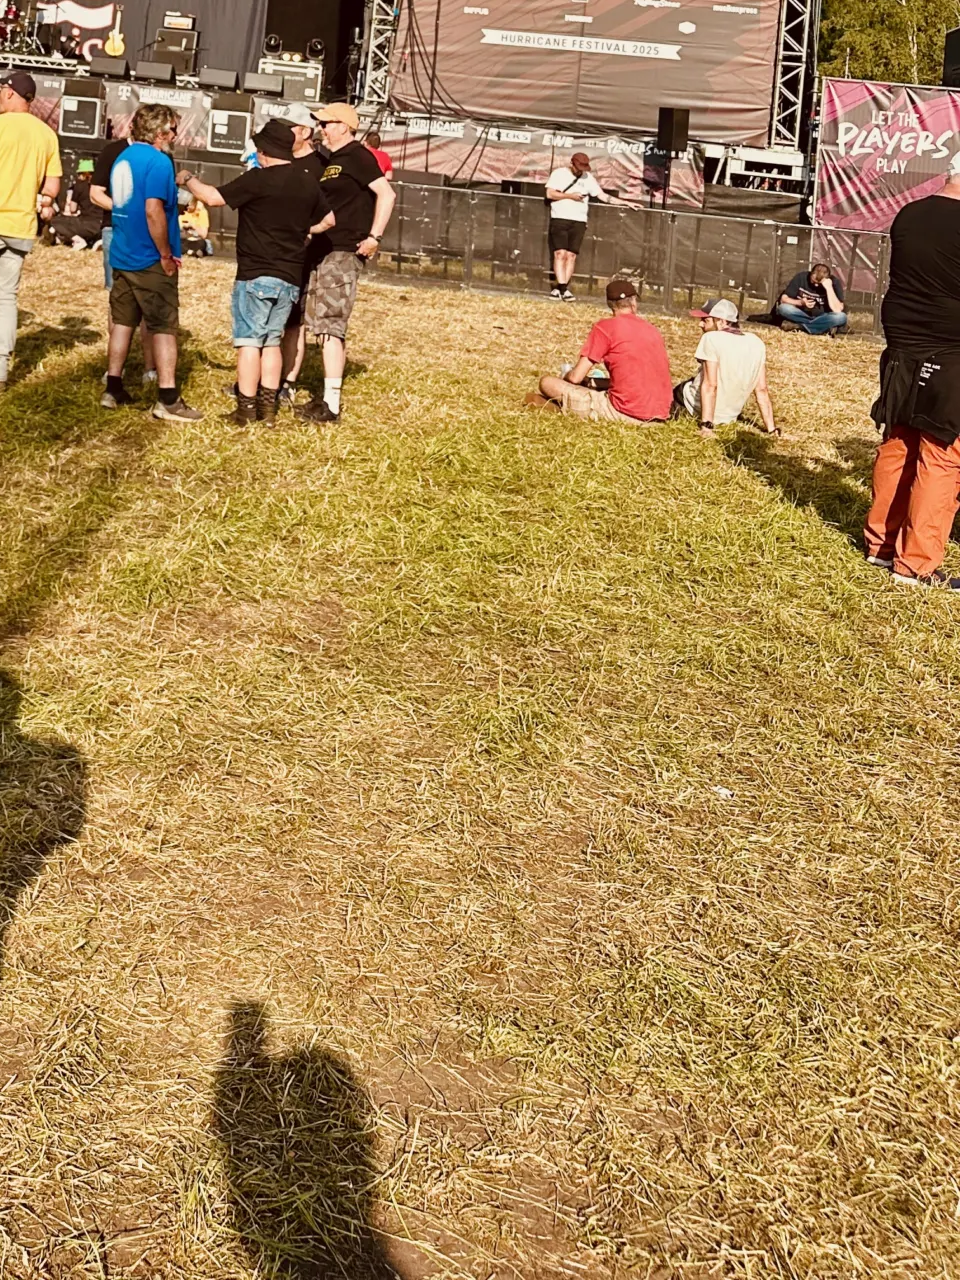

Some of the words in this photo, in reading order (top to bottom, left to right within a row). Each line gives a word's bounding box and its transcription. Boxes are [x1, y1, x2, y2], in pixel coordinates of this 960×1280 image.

[501, 33, 567, 48] HURRICANE
[572, 39, 627, 53] FESTIVAL
[632, 44, 660, 56] 2025
[140, 87, 193, 103] HURRICANE
[871, 109, 895, 125] LET
[897, 111, 919, 128] THE
[542, 134, 574, 148] EWE
[606, 139, 653, 156] PLAYERS
[836, 121, 954, 159] PLAYERS
[876, 158, 908, 174] PLAY
